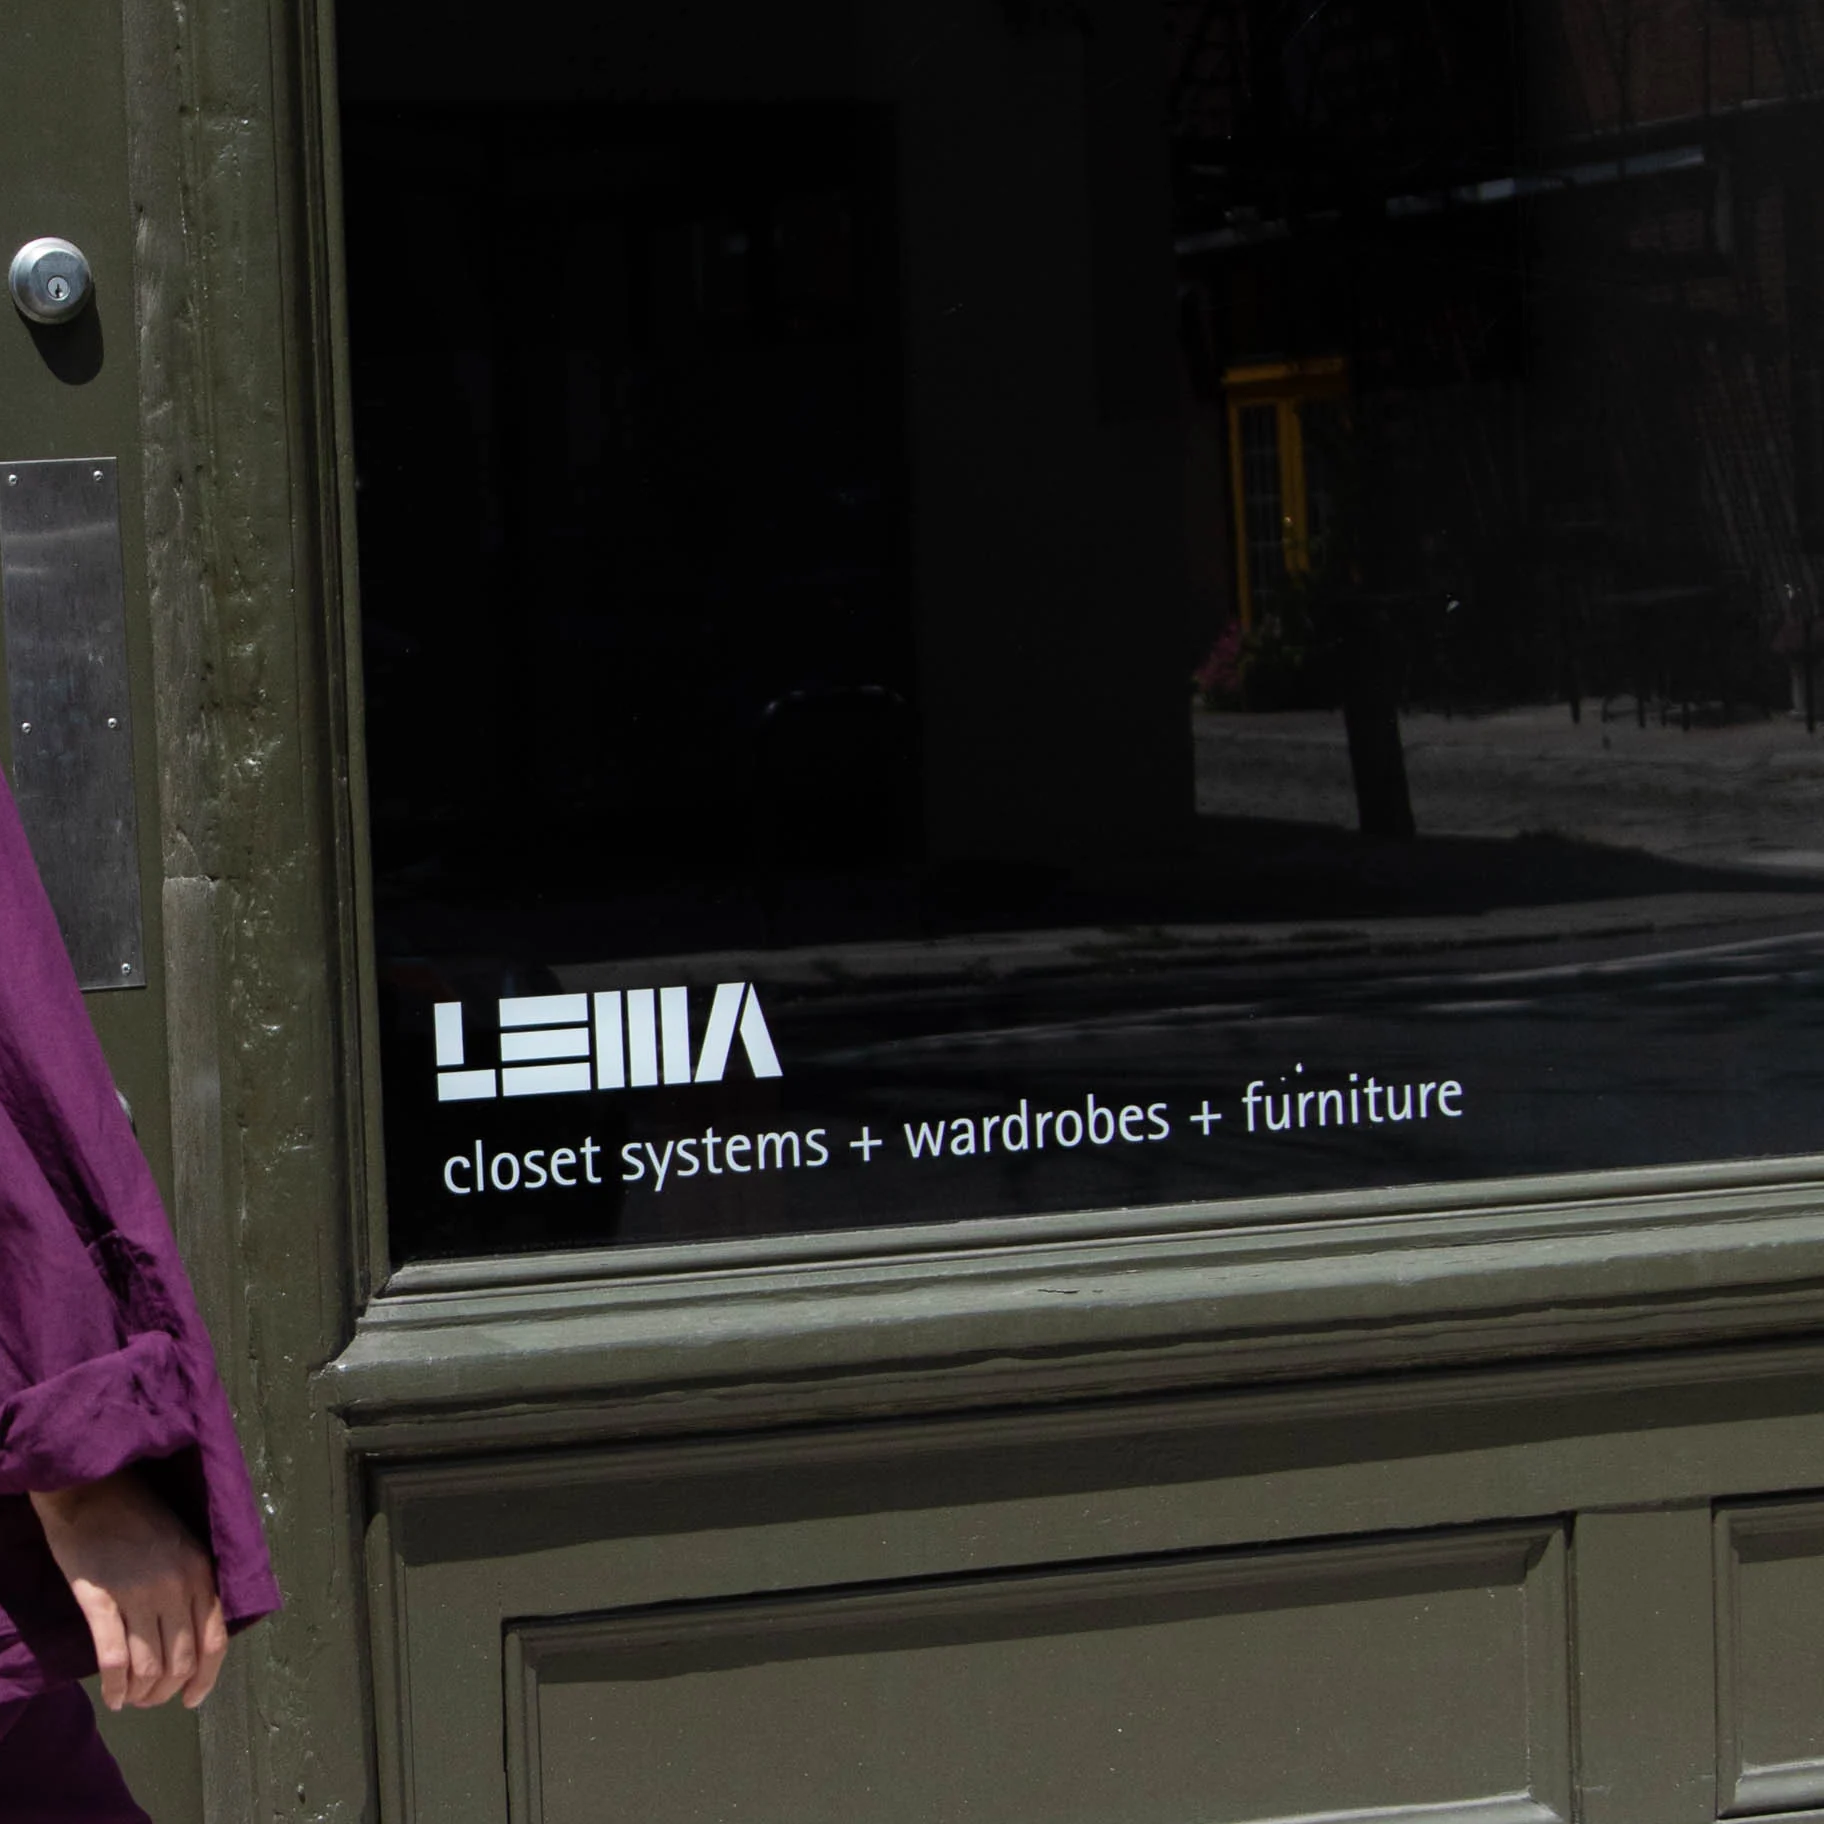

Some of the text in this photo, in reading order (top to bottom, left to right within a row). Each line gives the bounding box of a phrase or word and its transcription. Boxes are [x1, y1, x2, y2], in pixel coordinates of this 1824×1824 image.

[434, 982, 783, 1102] LEMA
[443, 1072, 1463, 1194] closet systems + wardrobes + furniture
